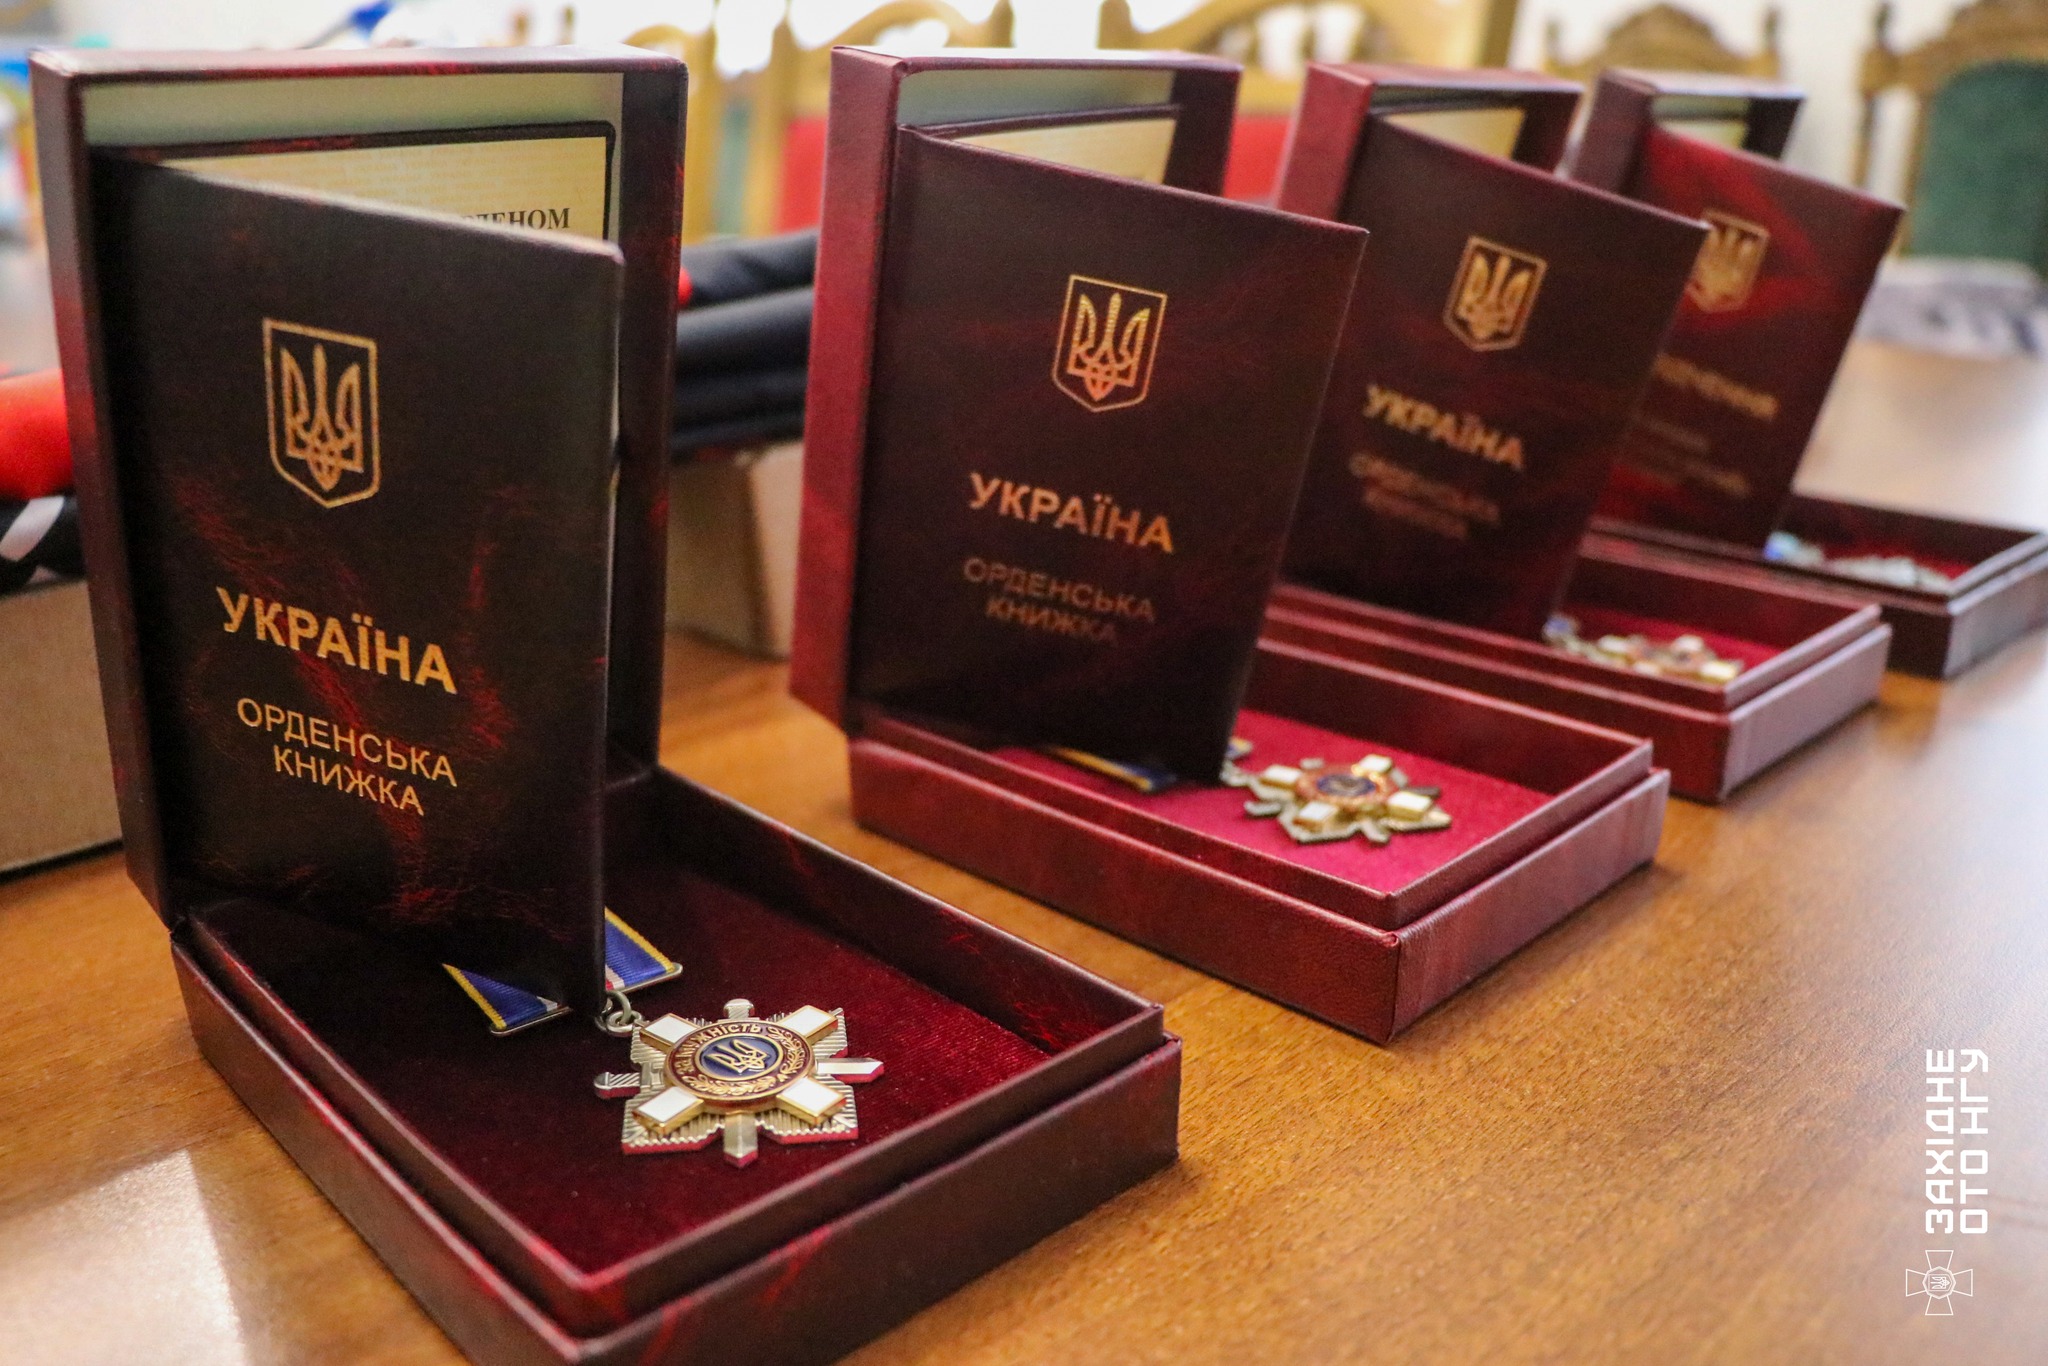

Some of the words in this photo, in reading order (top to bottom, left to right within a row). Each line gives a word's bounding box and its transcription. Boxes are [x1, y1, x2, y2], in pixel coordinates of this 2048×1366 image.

[1363, 384, 1524, 470] УКРАЇНА
[969, 472, 1174, 554] УКРАЇНА
[963, 557, 1156, 624] ОРДЕНСЬКА
[216, 586, 457, 695] УКРАЇНА
[237, 698, 457, 788] ОРДЕНСЬКА
[273, 744, 425, 817] КНИЖКА
